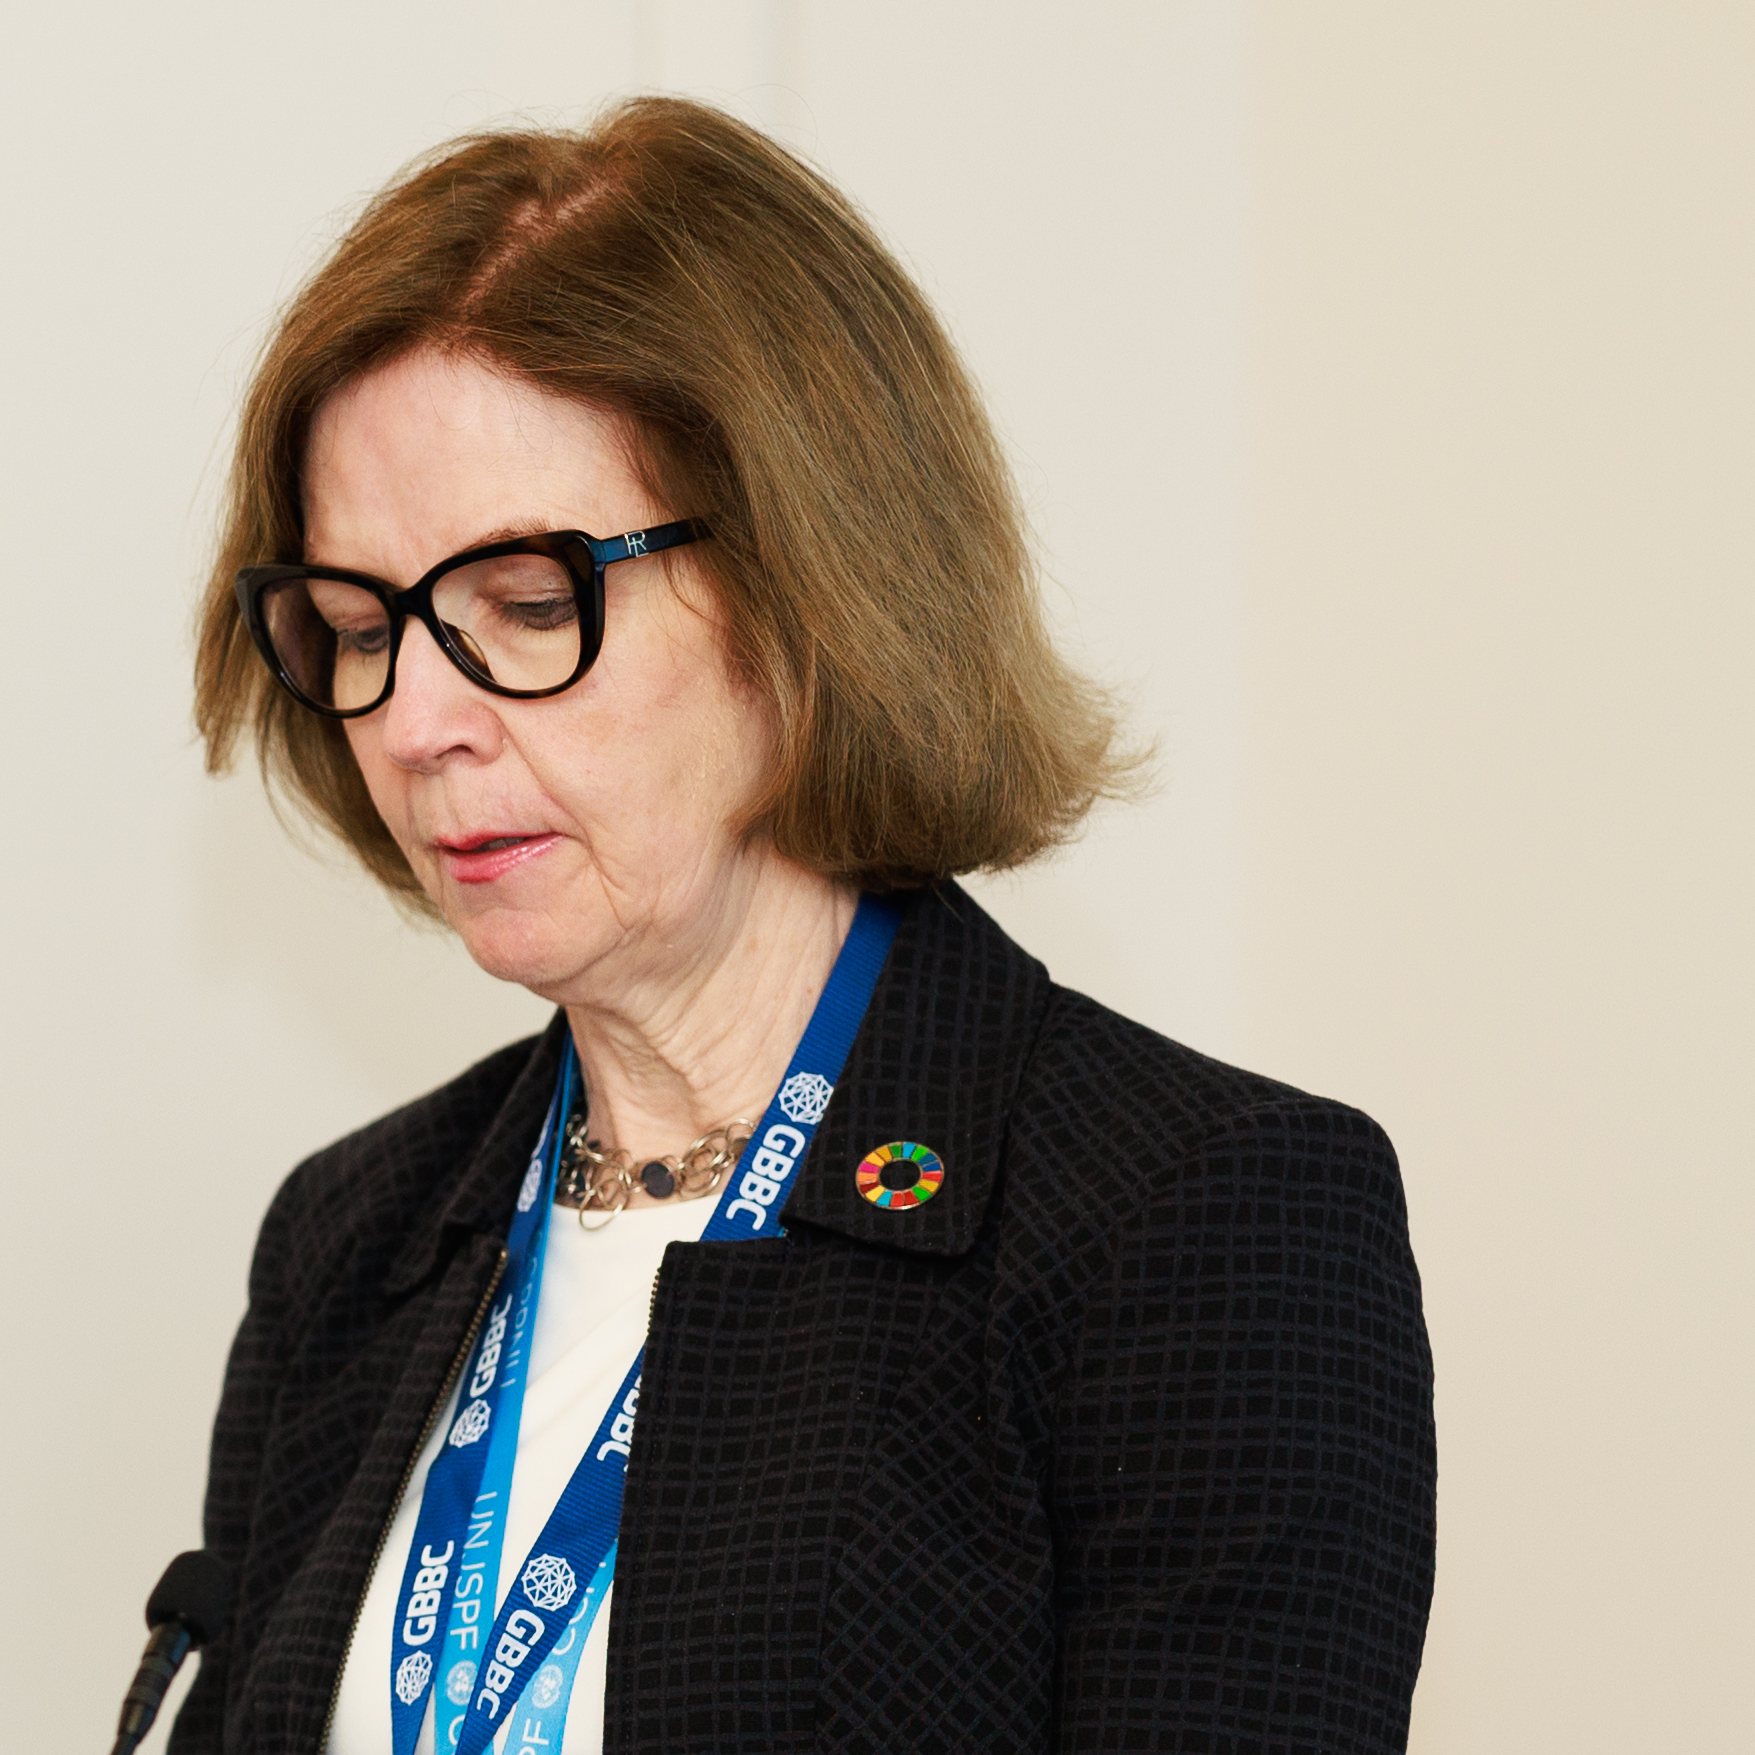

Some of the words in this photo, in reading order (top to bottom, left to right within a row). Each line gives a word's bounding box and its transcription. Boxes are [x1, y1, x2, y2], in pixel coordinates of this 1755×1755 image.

[726, 1124, 806, 1231] GBBC
[470, 1293, 512, 1398] GBBC
[403, 1540, 454, 1646] GBBC
[476, 1609, 545, 1719] GBBC
